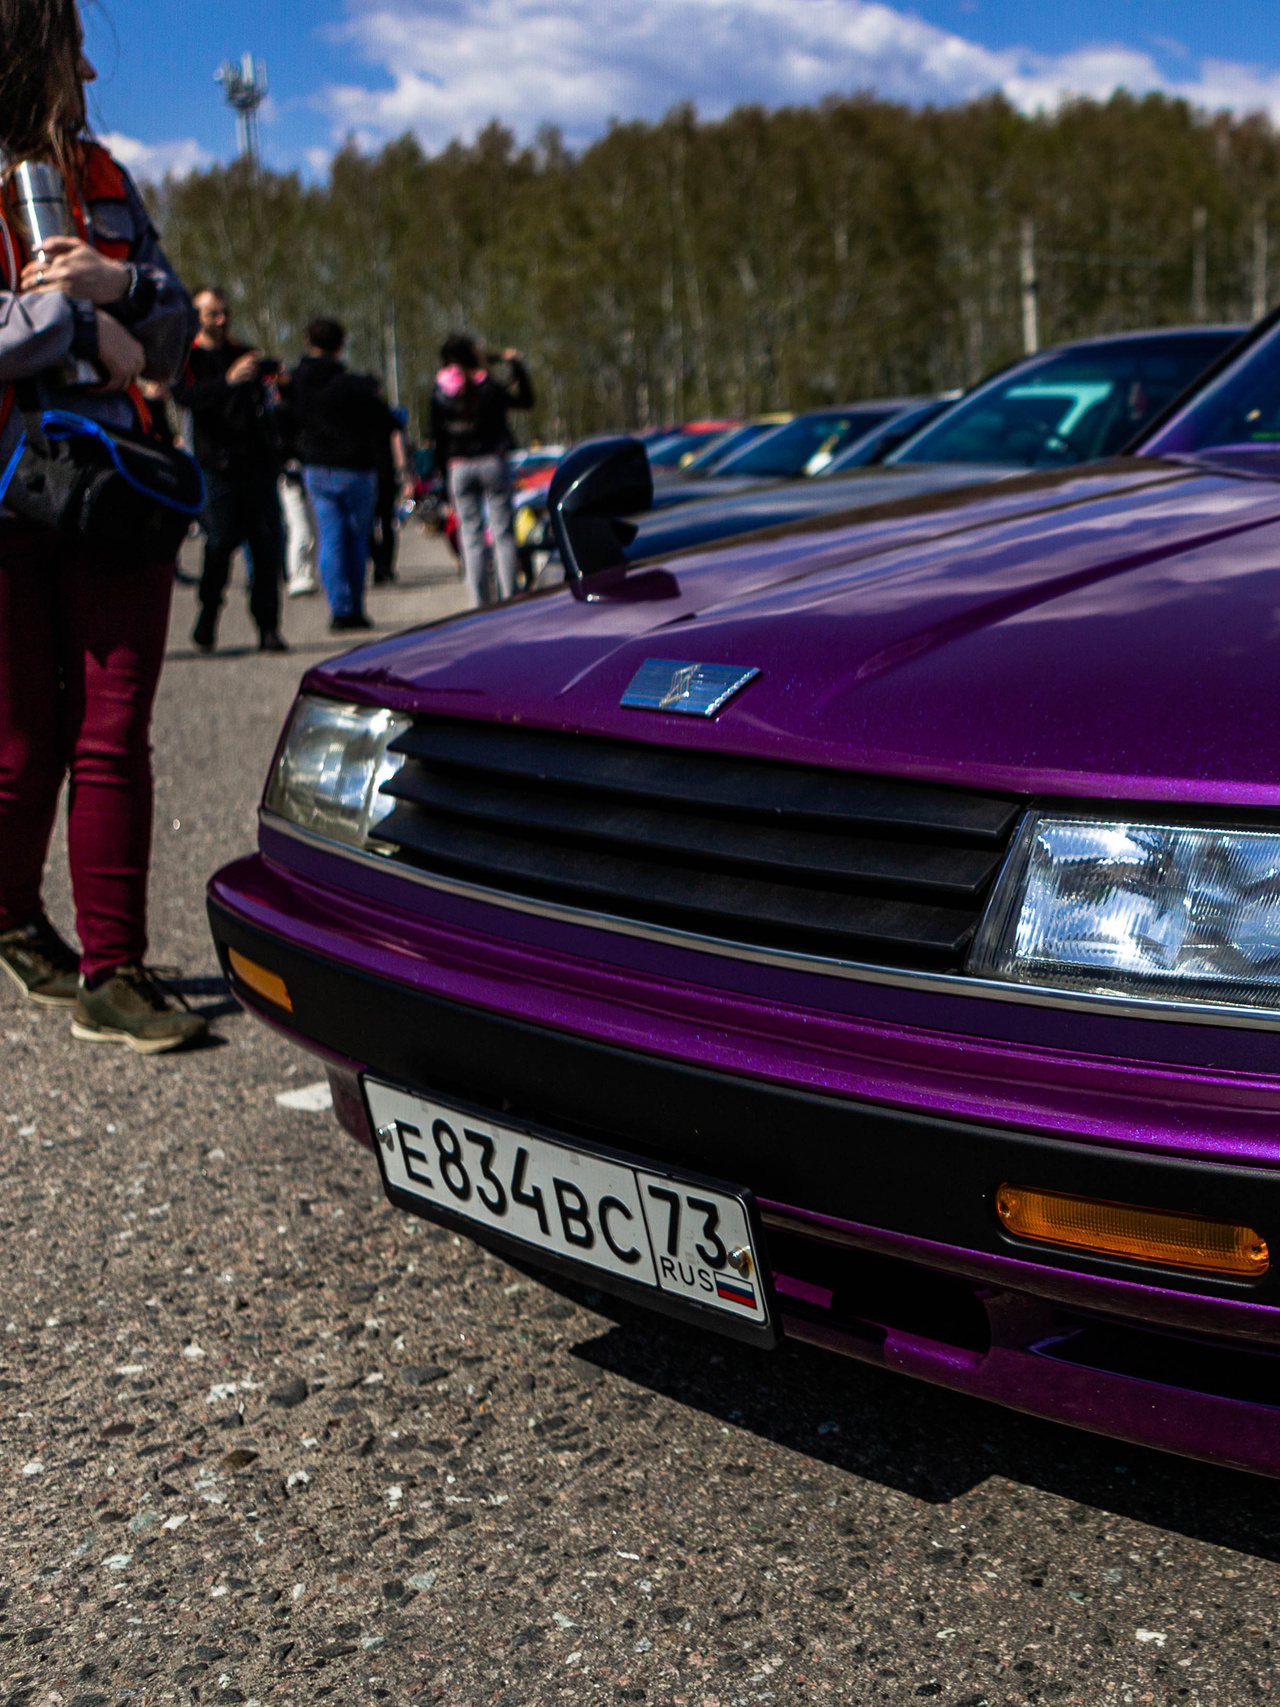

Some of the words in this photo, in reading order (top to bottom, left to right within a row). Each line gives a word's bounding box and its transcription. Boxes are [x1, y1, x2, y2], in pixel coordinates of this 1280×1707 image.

[394, 1118, 642, 1264] E834BC
[648, 1185, 728, 1270] 73
[660, 1256, 715, 1292] RUS
